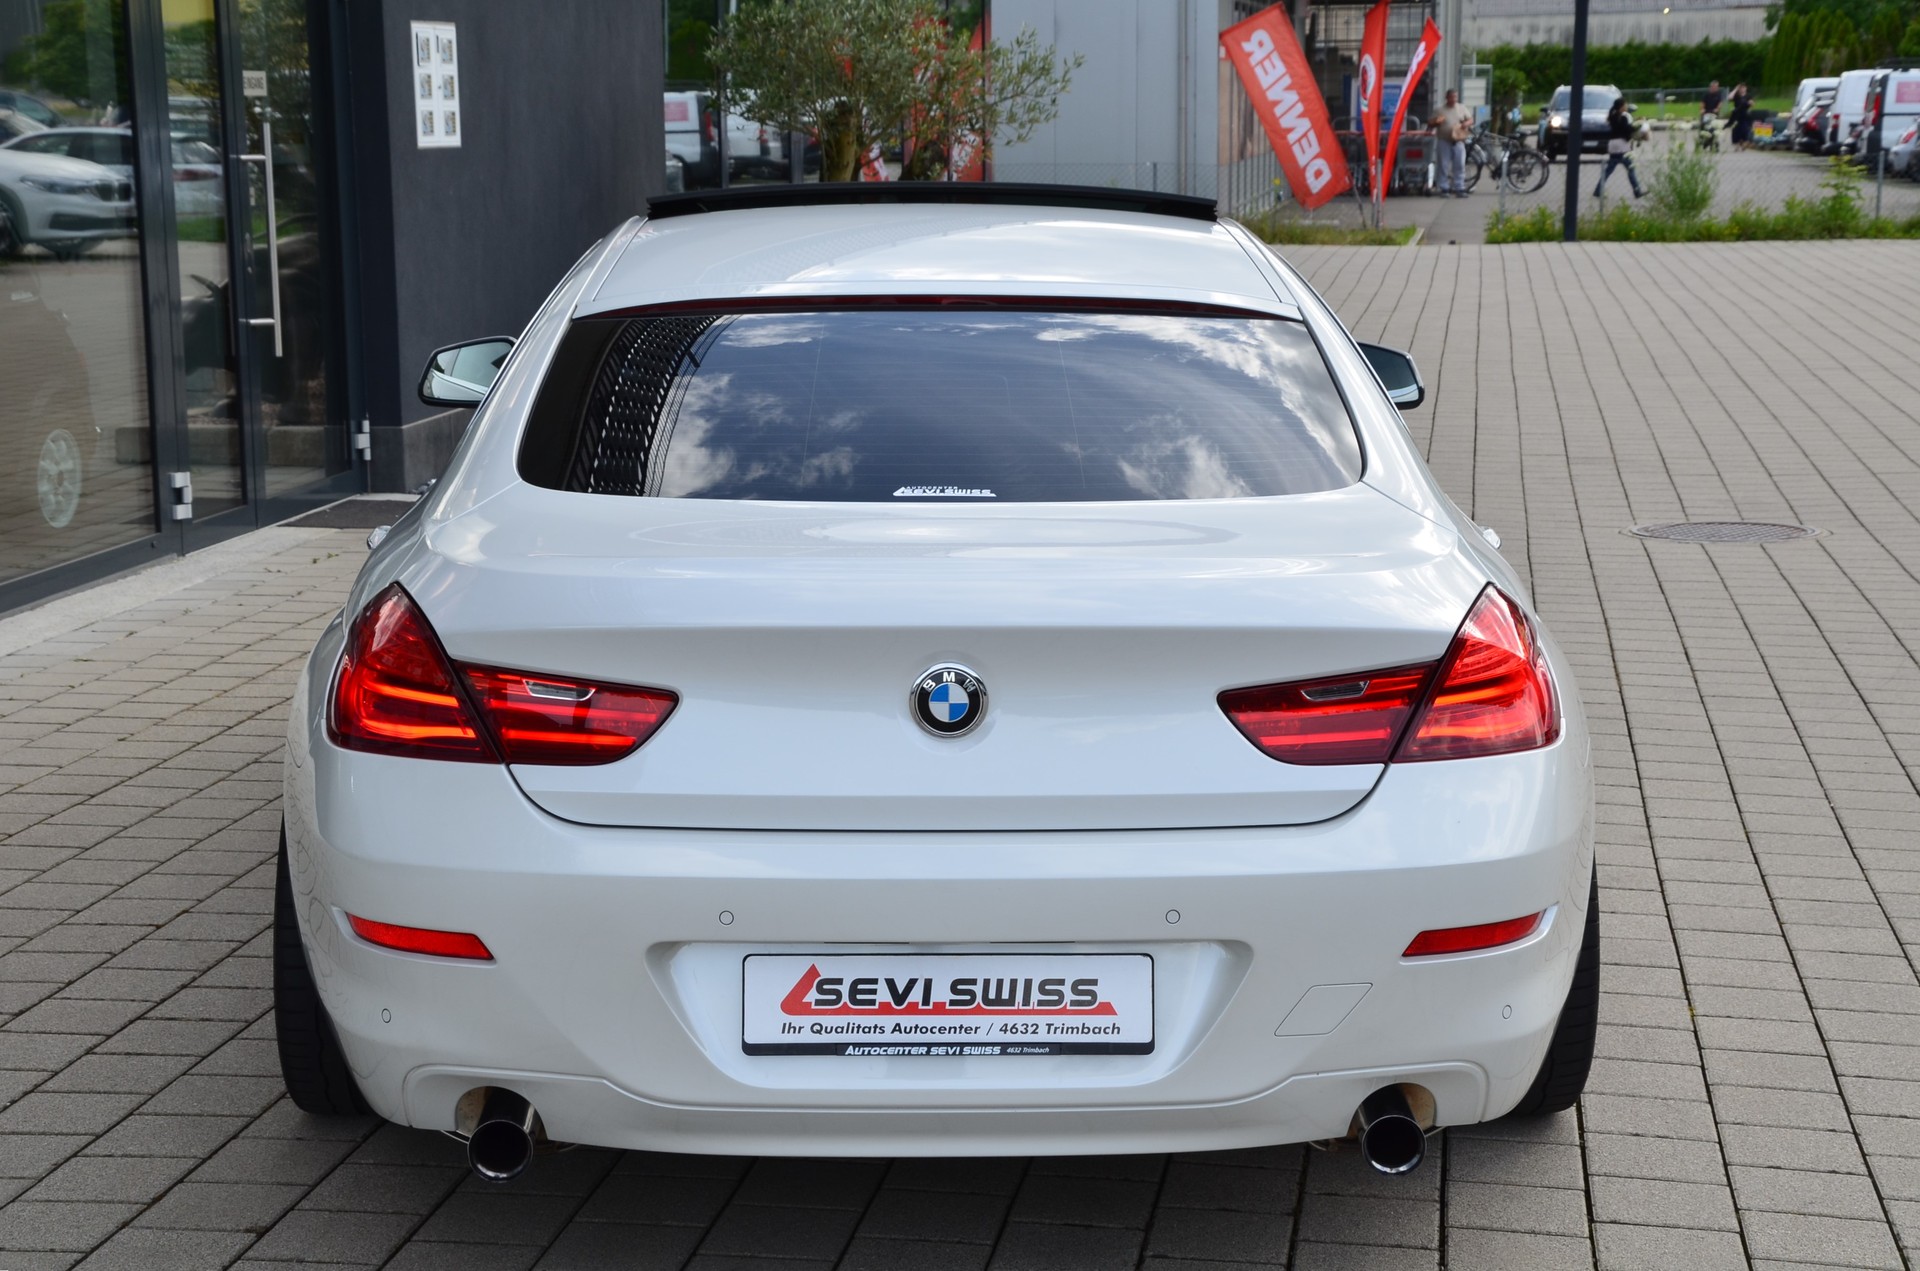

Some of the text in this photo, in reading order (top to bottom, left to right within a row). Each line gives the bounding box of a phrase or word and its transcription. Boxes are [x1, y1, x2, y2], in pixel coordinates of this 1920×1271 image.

[923, 671, 977, 693] BMW
[814, 978, 1099, 1007] SEVI SWISS
[781, 1022, 1121, 1036] Ihr Qualitats Autocenter / 4632 Trimbach
[844, 1045, 928, 1056] AUTOCENTER
[929, 1045, 960, 1056] SEVI
[962, 1045, 1001, 1056] SWISS
